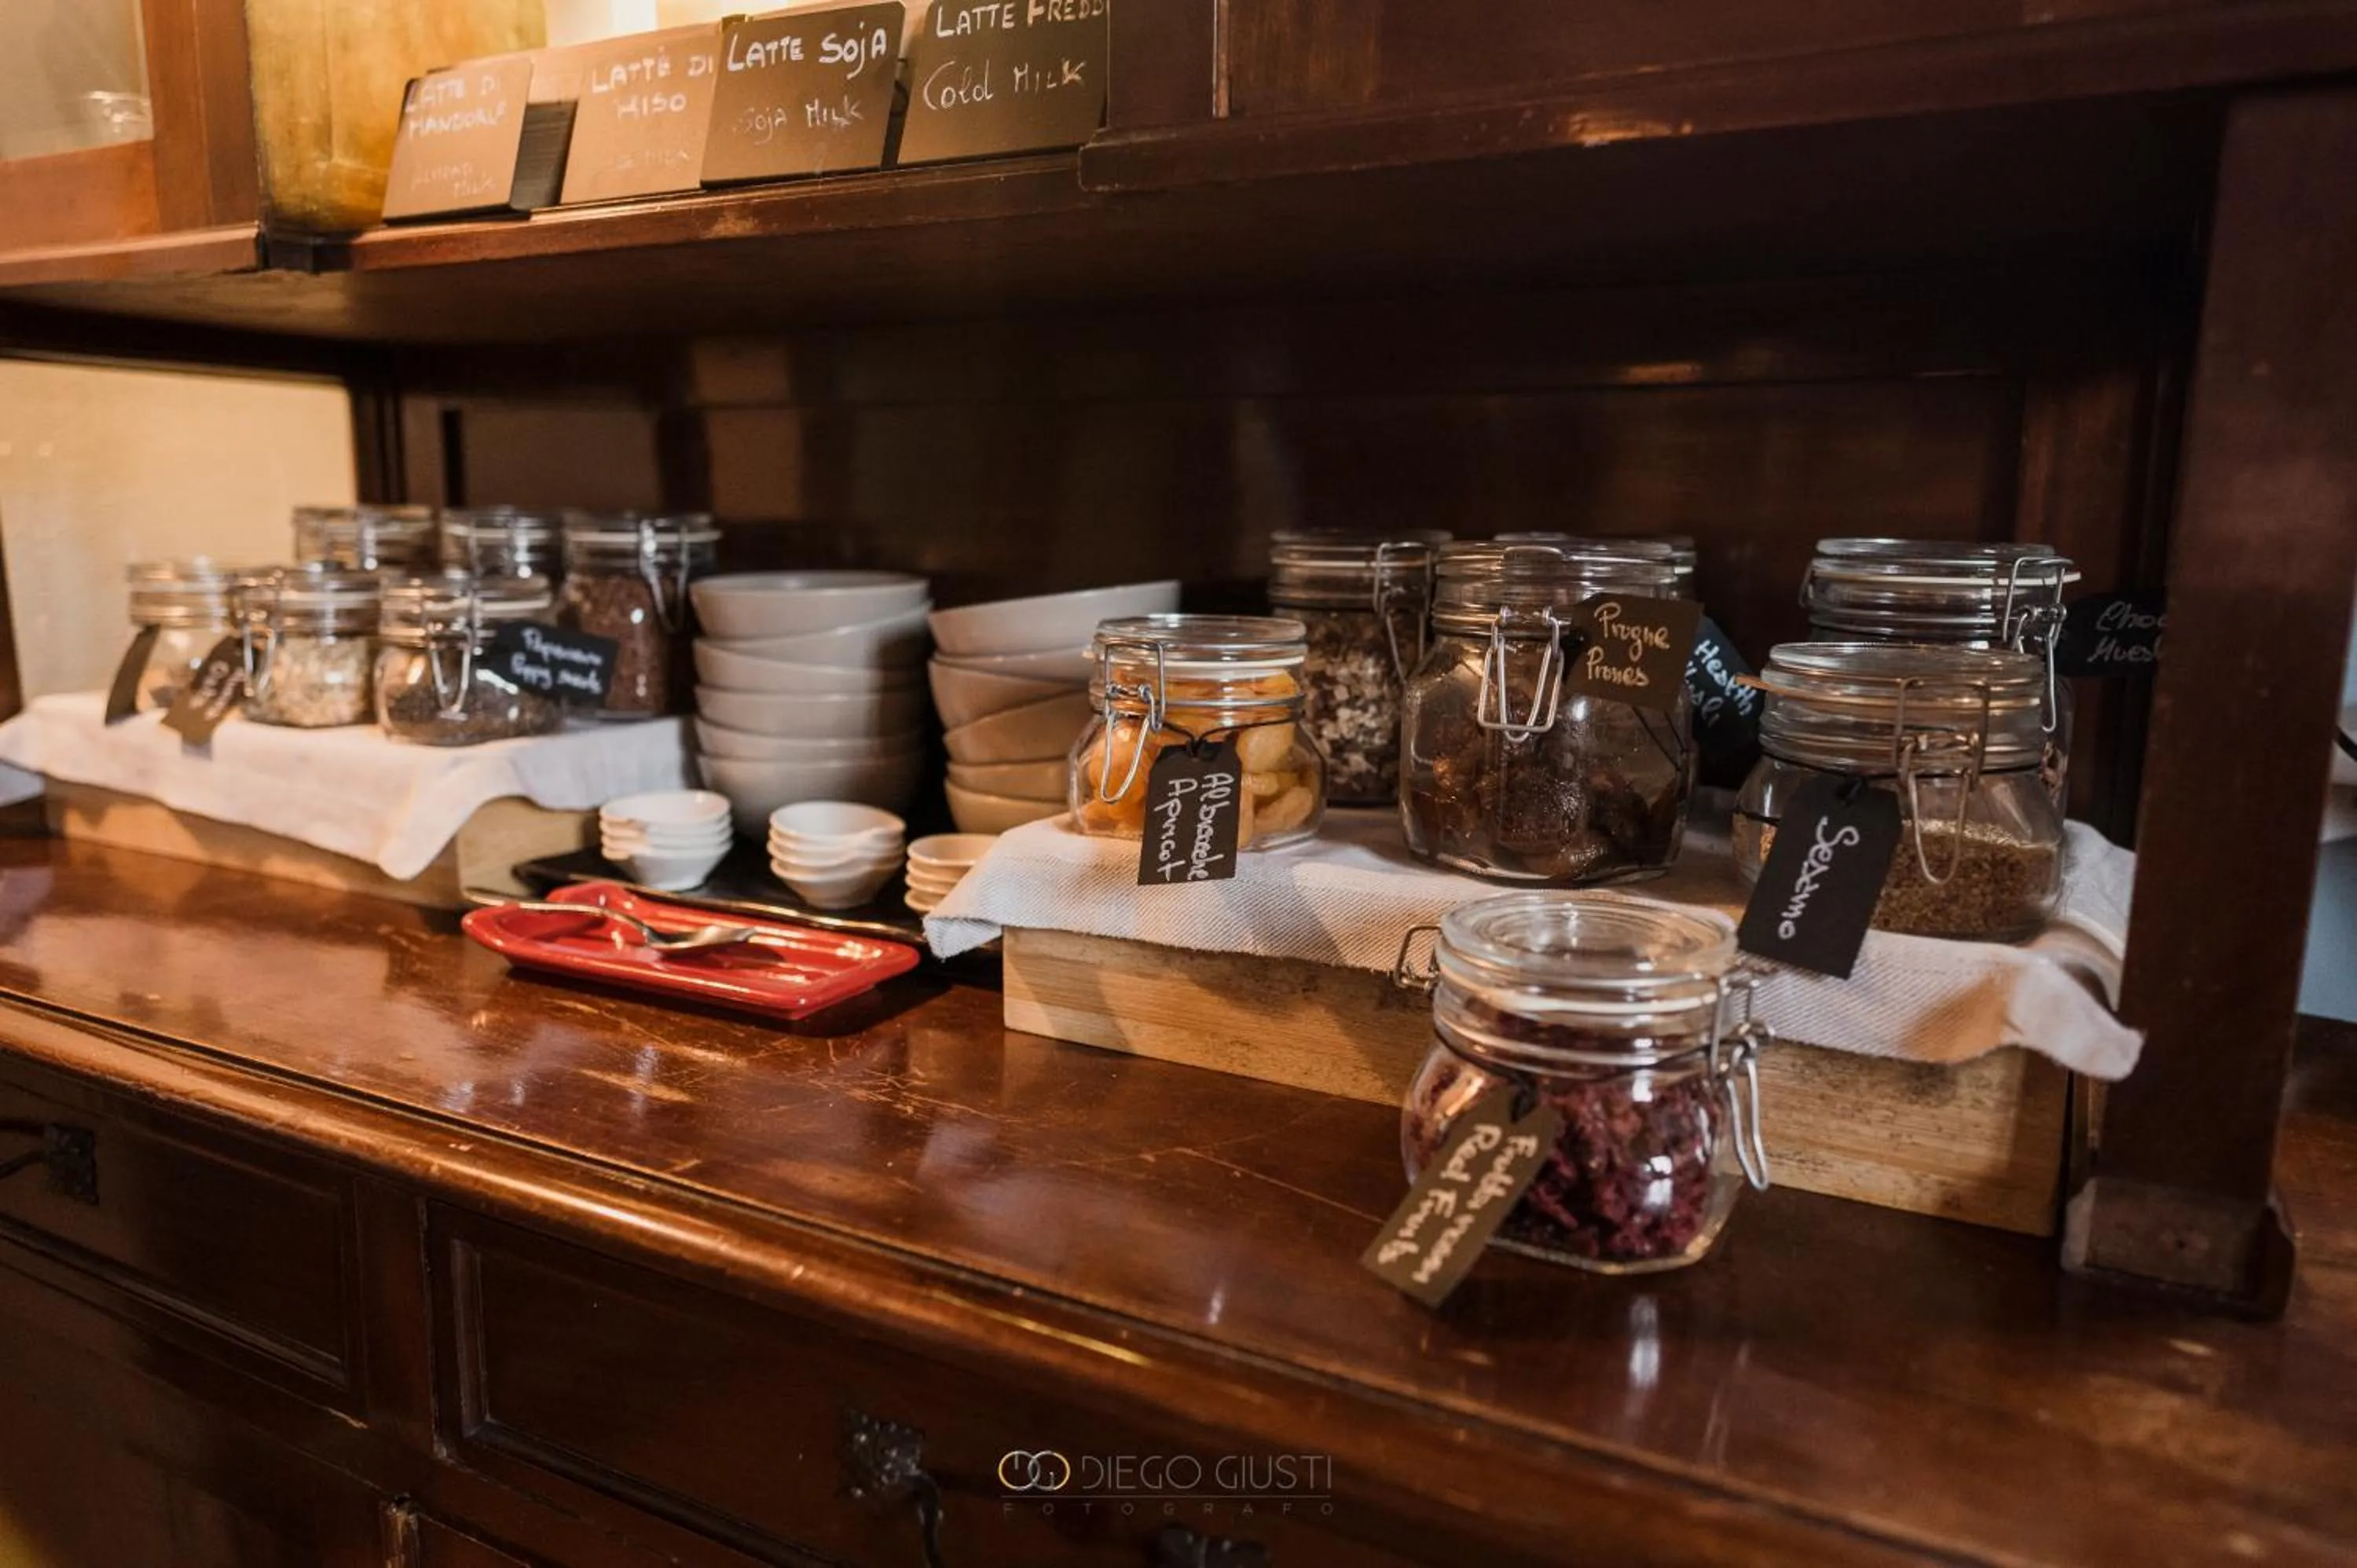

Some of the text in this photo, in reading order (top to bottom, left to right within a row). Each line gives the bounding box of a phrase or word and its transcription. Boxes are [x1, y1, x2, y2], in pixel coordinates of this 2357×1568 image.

[937, 3, 1015, 38] LATTE
[687, 54, 713, 77] DI
[728, 33, 804, 71] LATTE
[1593, 602, 1671, 662] Prugne
